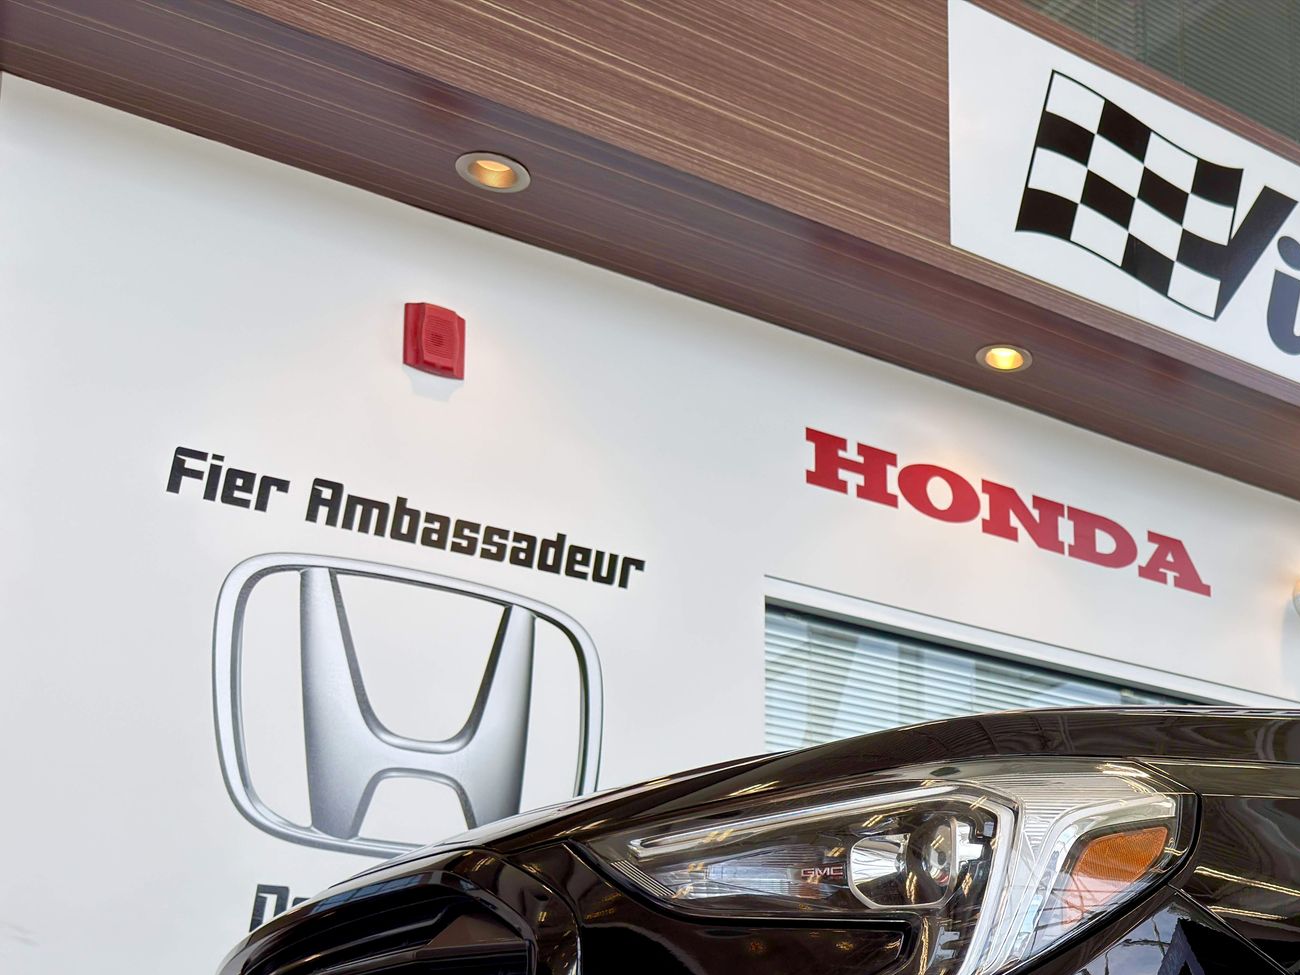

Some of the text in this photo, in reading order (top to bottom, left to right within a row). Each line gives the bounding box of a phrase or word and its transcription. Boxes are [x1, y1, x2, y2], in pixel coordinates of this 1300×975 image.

[166, 446, 645, 589] Fier Ambassadeur
[806, 427, 1211, 597] HONDA
[801, 866, 843, 877] GMC
